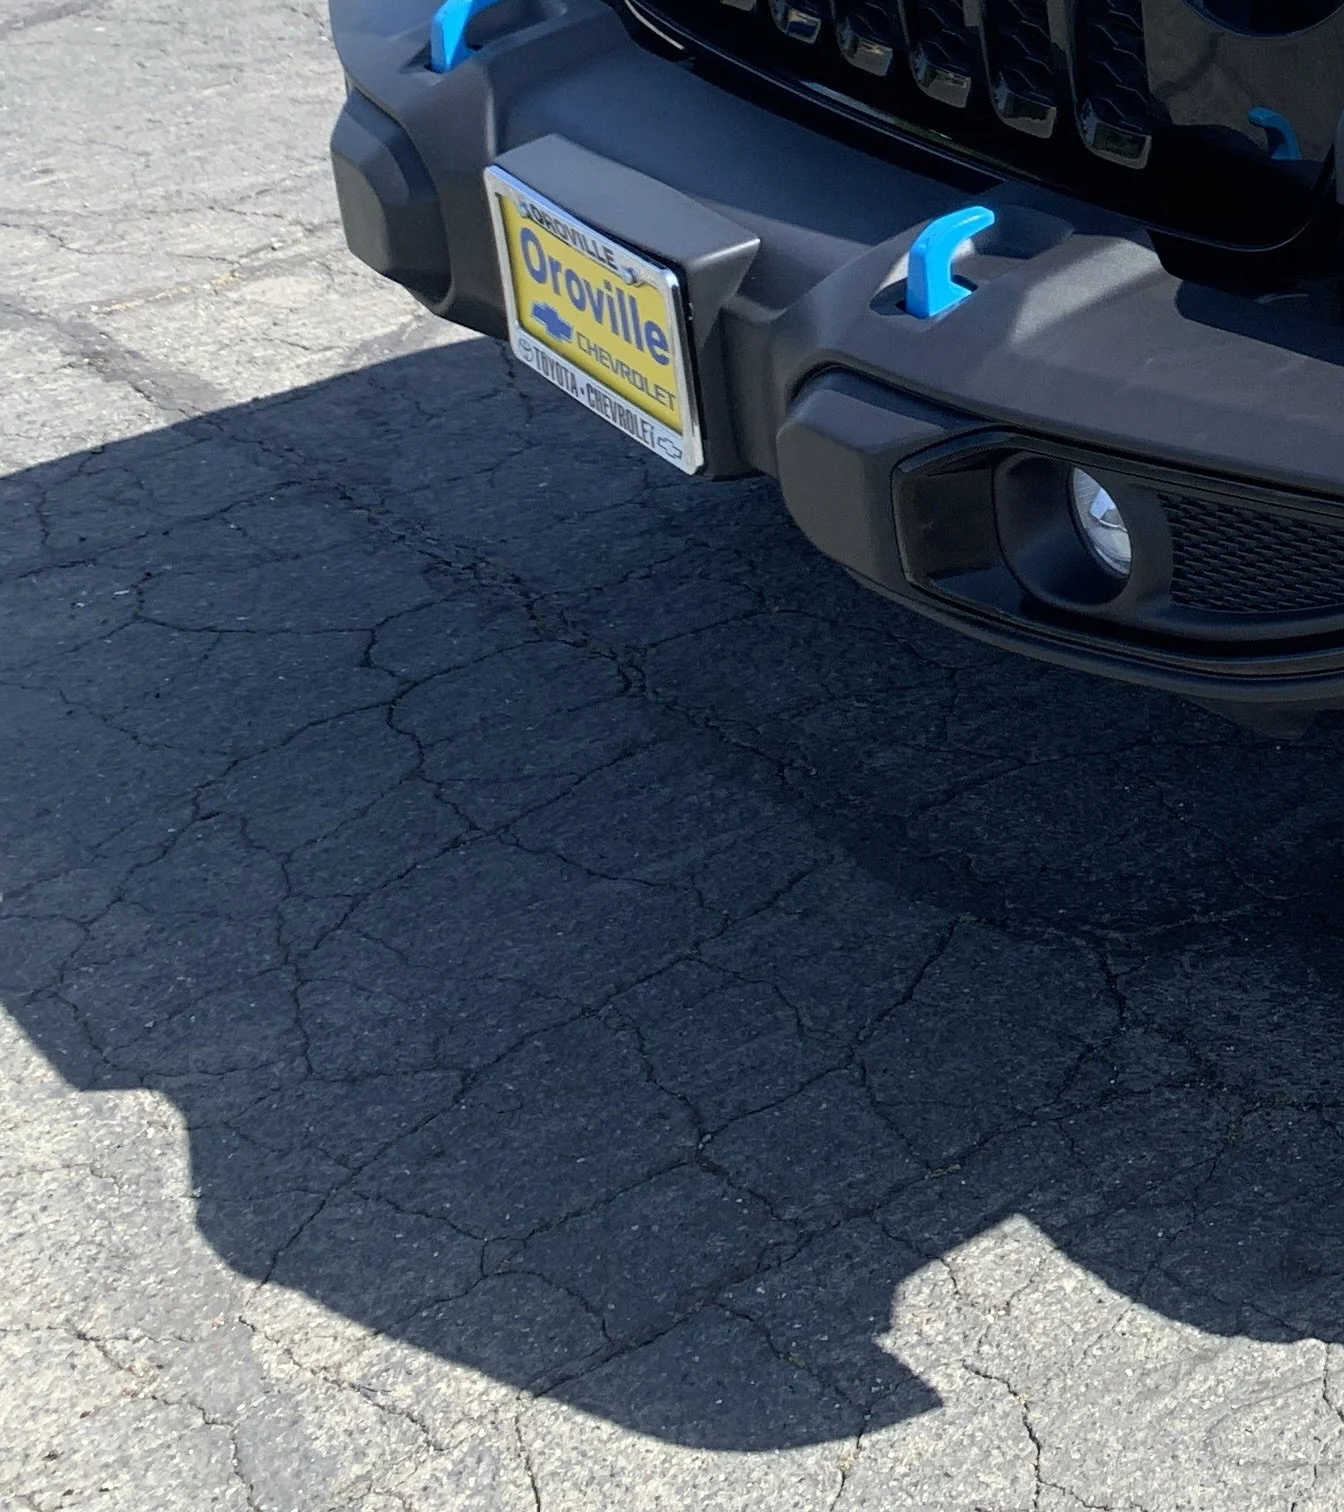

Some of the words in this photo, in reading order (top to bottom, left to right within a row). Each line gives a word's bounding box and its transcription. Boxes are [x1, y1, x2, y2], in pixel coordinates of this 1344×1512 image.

[529, 202, 620, 272] OROVILLE
[519, 226, 671, 366] Oroville
[532, 345, 578, 399] TOYOTA
[585, 381, 656, 447] CHEVROLET
[575, 330, 677, 412] CHEVROLET
